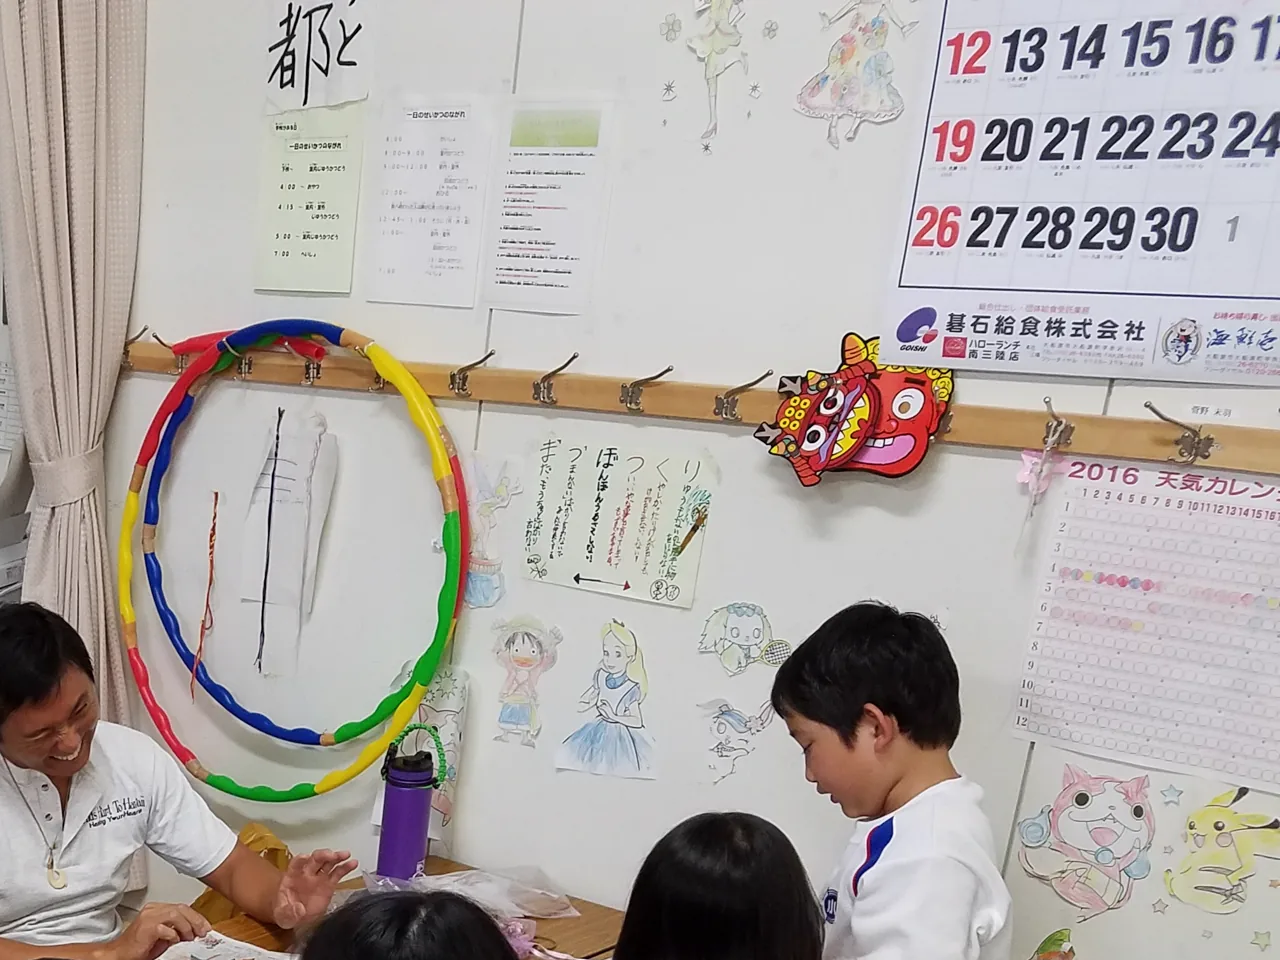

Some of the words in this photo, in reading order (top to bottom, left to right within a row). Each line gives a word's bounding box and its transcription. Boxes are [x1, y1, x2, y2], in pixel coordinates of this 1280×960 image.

[945, 30, 992, 76] 12
[1001, 26, 1048, 73] 13
[1059, 22, 1109, 71] 14
[1121, 19, 1173, 69] 15
[1184, 15, 1237, 65] 16
[1250, 14, 1280, 63] 1
[932, 118, 976, 164] 19
[980, 117, 1034, 163] 20
[1039, 116, 1091, 162] 21
[1096, 114, 1155, 161] 22
[1156, 112, 1218, 161] 23
[1221, 110, 1280, 159] 24
[911, 205, 962, 249] 26
[965, 205, 1020, 249] 27
[1020, 206, 1073, 250] 28
[1078, 206, 1135, 252] 29
[1140, 206, 1199, 253] 30
[1225, 215, 1240, 243] 1
[945, 312, 1146, 342] 碁石給食株式会社
[969, 339, 1021, 350] ハローランチ
[968, 349, 1020, 362] 南三陸店
[1068, 461, 1140, 485] 2016
[1064, 501, 1070, 512] 1
[1082, 488, 1088, 498] 1
[1093, 489, 1100, 499] 2
[1104, 490, 1112, 500] 3
[1116, 492, 1123, 502] 4
[1128, 494, 1135, 504] 5
[1139, 495, 1147, 505] 6
[1152, 496, 1160, 506] 7
[1164, 498, 1171, 508] 8
[1176, 500, 1184, 509] 9
[1188, 501, 1199, 511] 10
[1199, 502, 1211, 513] 11
[1212, 503, 1224, 514] 12
[1225, 505, 1237, 516] 13
[1237, 506, 1250, 518] 14
[1250, 508, 1263, 520] 15
[1262, 509, 1275, 521] 16
[1058, 522, 1066, 533] 2
[1053, 542, 1062, 553] 3
[1044, 582, 1052, 593] 5
[1040, 602, 1048, 613] 6
[1035, 621, 1043, 632] 7
[1031, 641, 1039, 652] 8
[1027, 660, 1035, 671] 9
[1021, 679, 1034, 690] 10
[1018, 698, 1030, 709] 11
[1015, 715, 1028, 727] 12
